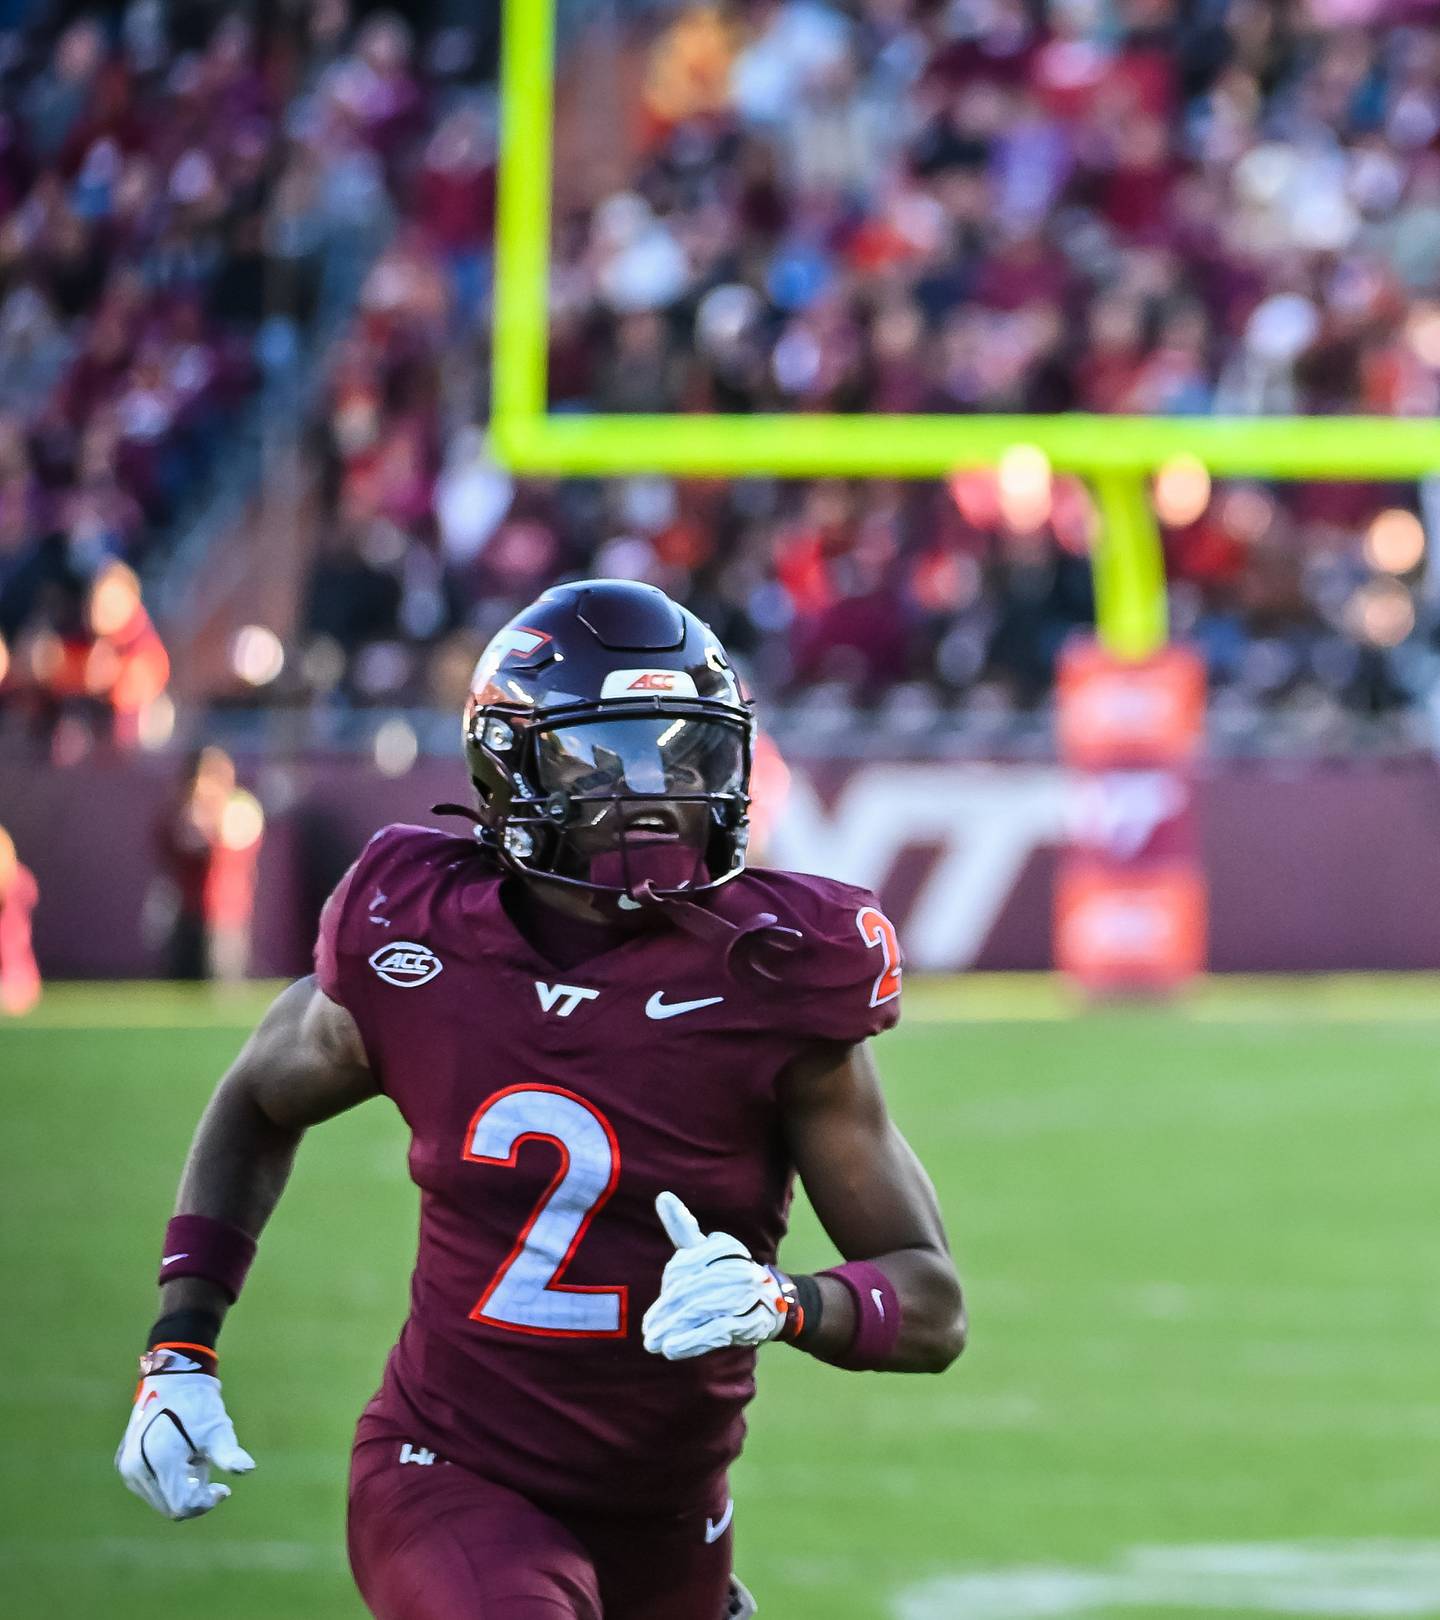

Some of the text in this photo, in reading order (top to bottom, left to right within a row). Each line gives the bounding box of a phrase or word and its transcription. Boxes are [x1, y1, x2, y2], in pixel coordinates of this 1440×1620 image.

[627, 674, 675, 690] ACC
[381, 952, 434, 971] ACC
[856, 906, 902, 1008] 2
[534, 981, 600, 1017] VT
[462, 1083, 628, 1338] 2
